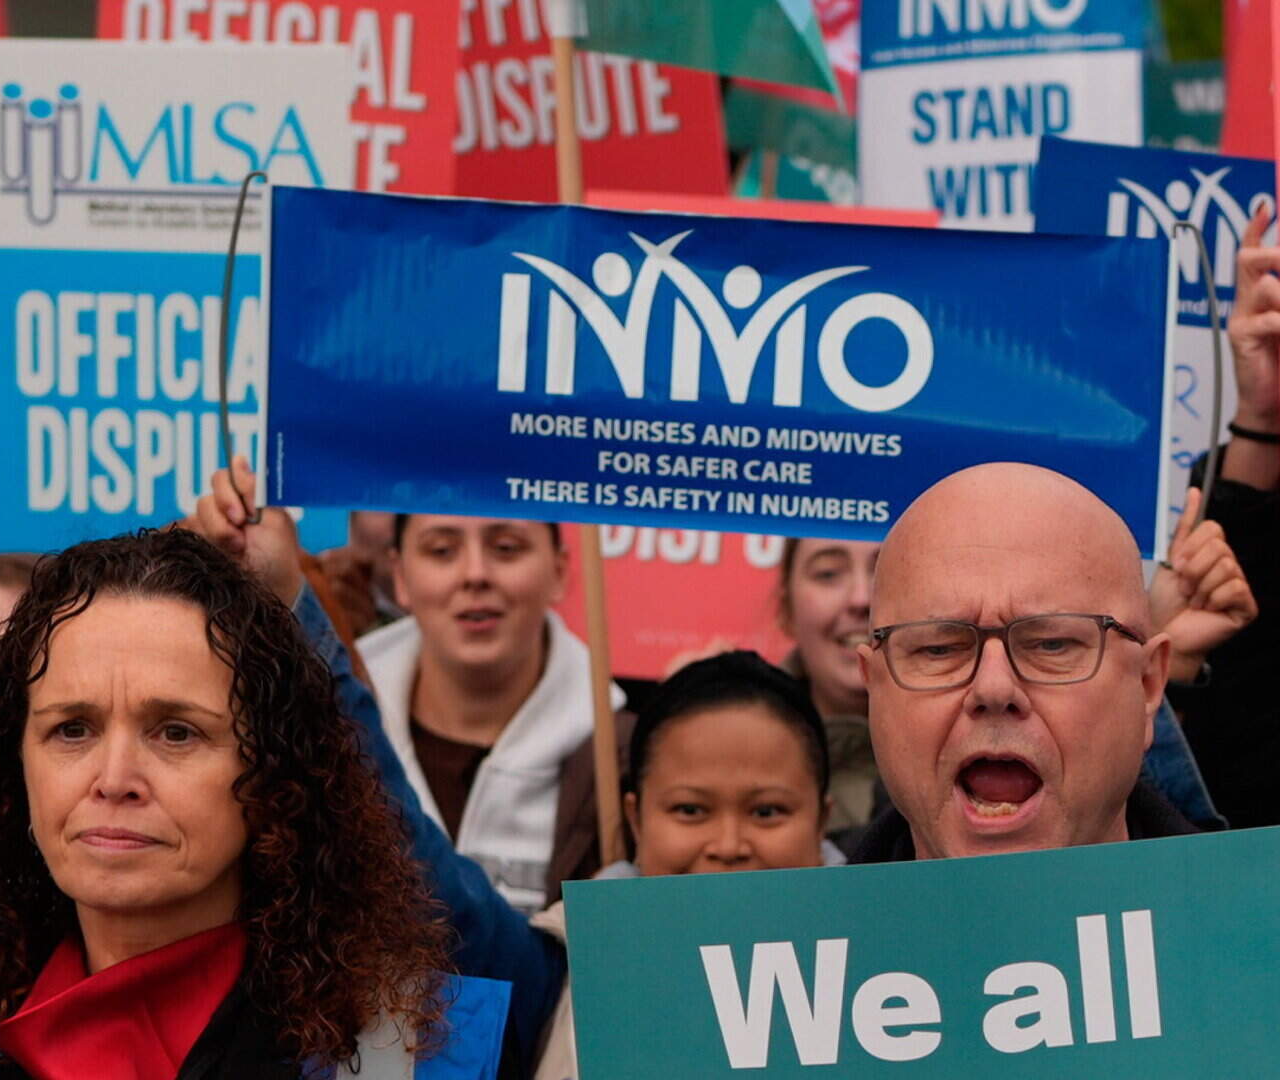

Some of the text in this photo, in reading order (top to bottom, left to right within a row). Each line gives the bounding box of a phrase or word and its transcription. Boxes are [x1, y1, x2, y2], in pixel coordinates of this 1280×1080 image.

[88, 100, 326, 188] MLSA
[912, 82, 1071, 144] STAND
[1106, 166, 1277, 288] IN
[16, 289, 263, 403] OFFICIA
[497, 229, 935, 412] INMO
[27, 405, 262, 516] DISPUT
[510, 413, 902, 457] MORE NURSES AND MIDWIVES
[598, 451, 813, 484] FOR SAFER CARE
[507, 478, 891, 523] THERE IS SAFETY IN NUMBERS
[699, 909, 1163, 1069] We all
